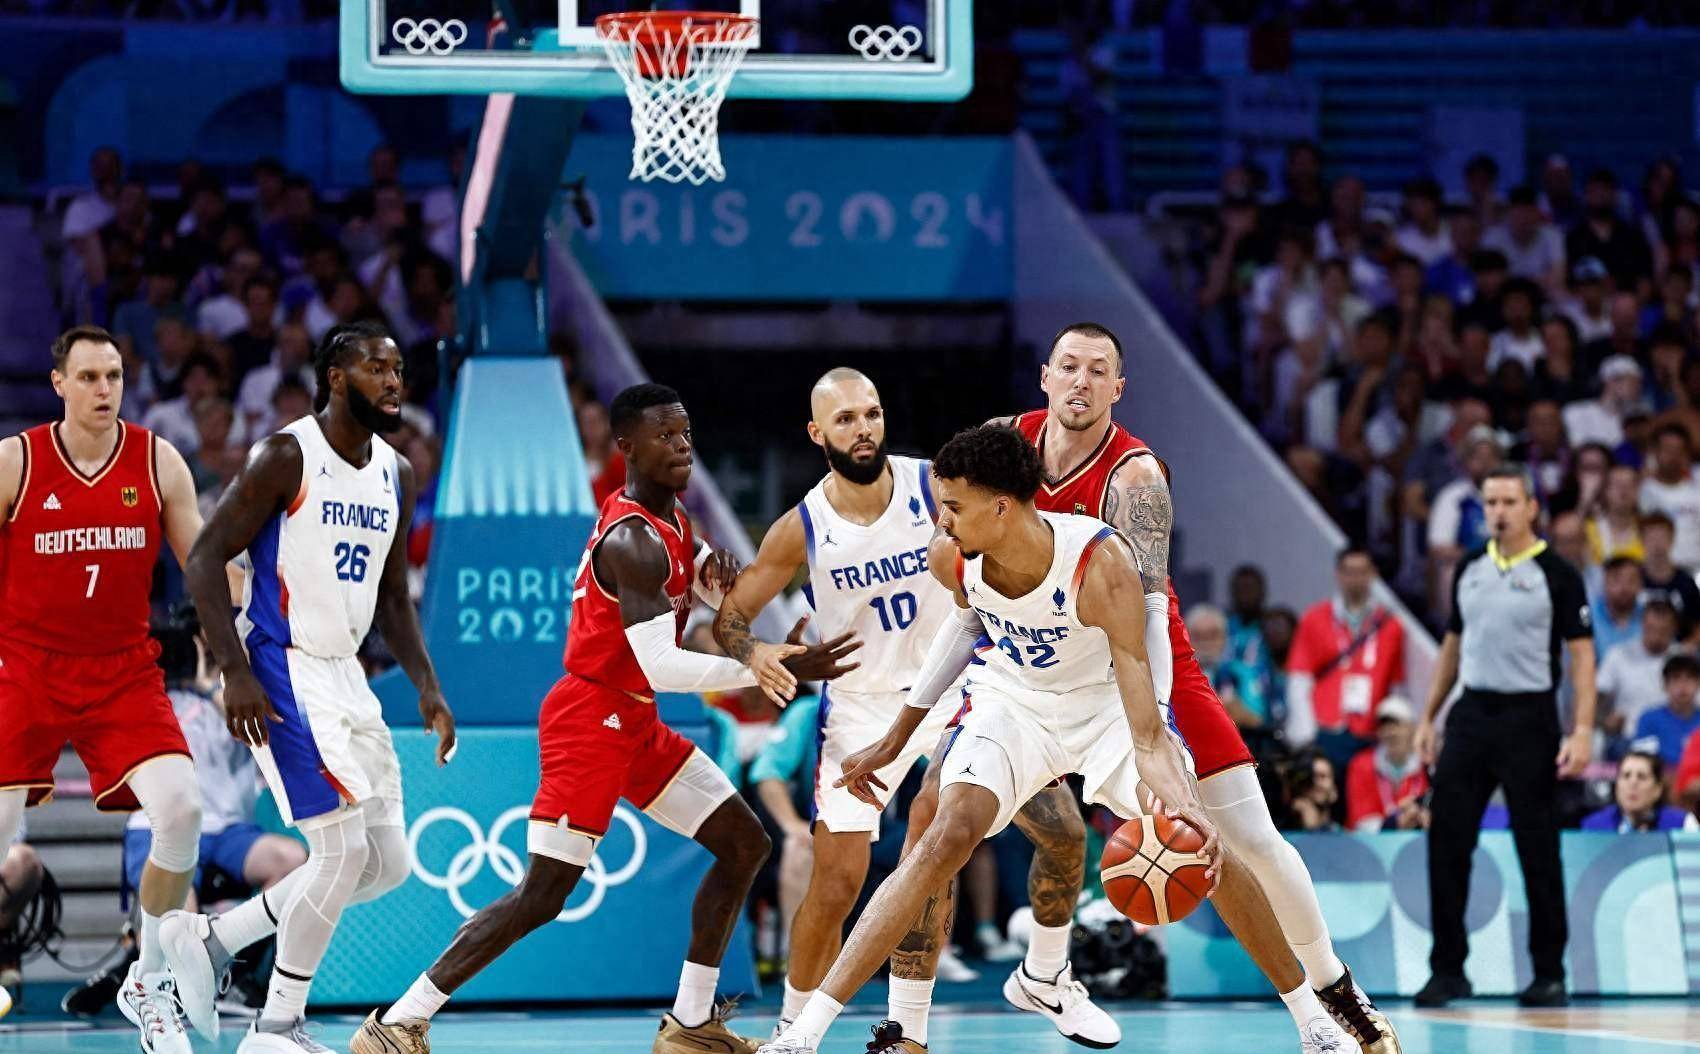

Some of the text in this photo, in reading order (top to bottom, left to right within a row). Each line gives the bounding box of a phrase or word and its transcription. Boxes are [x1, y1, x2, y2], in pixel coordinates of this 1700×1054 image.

[785, 190, 1004, 247] 2024
[322, 500, 389, 533] FRANCE
[34, 526, 146, 554] DEUTSCHLAND
[85, 564, 100, 598] 7
[334, 541, 370, 583] 26
[830, 546, 930, 590] FRANCE
[458, 607, 573, 642] 202
[868, 591, 918, 632] 10
